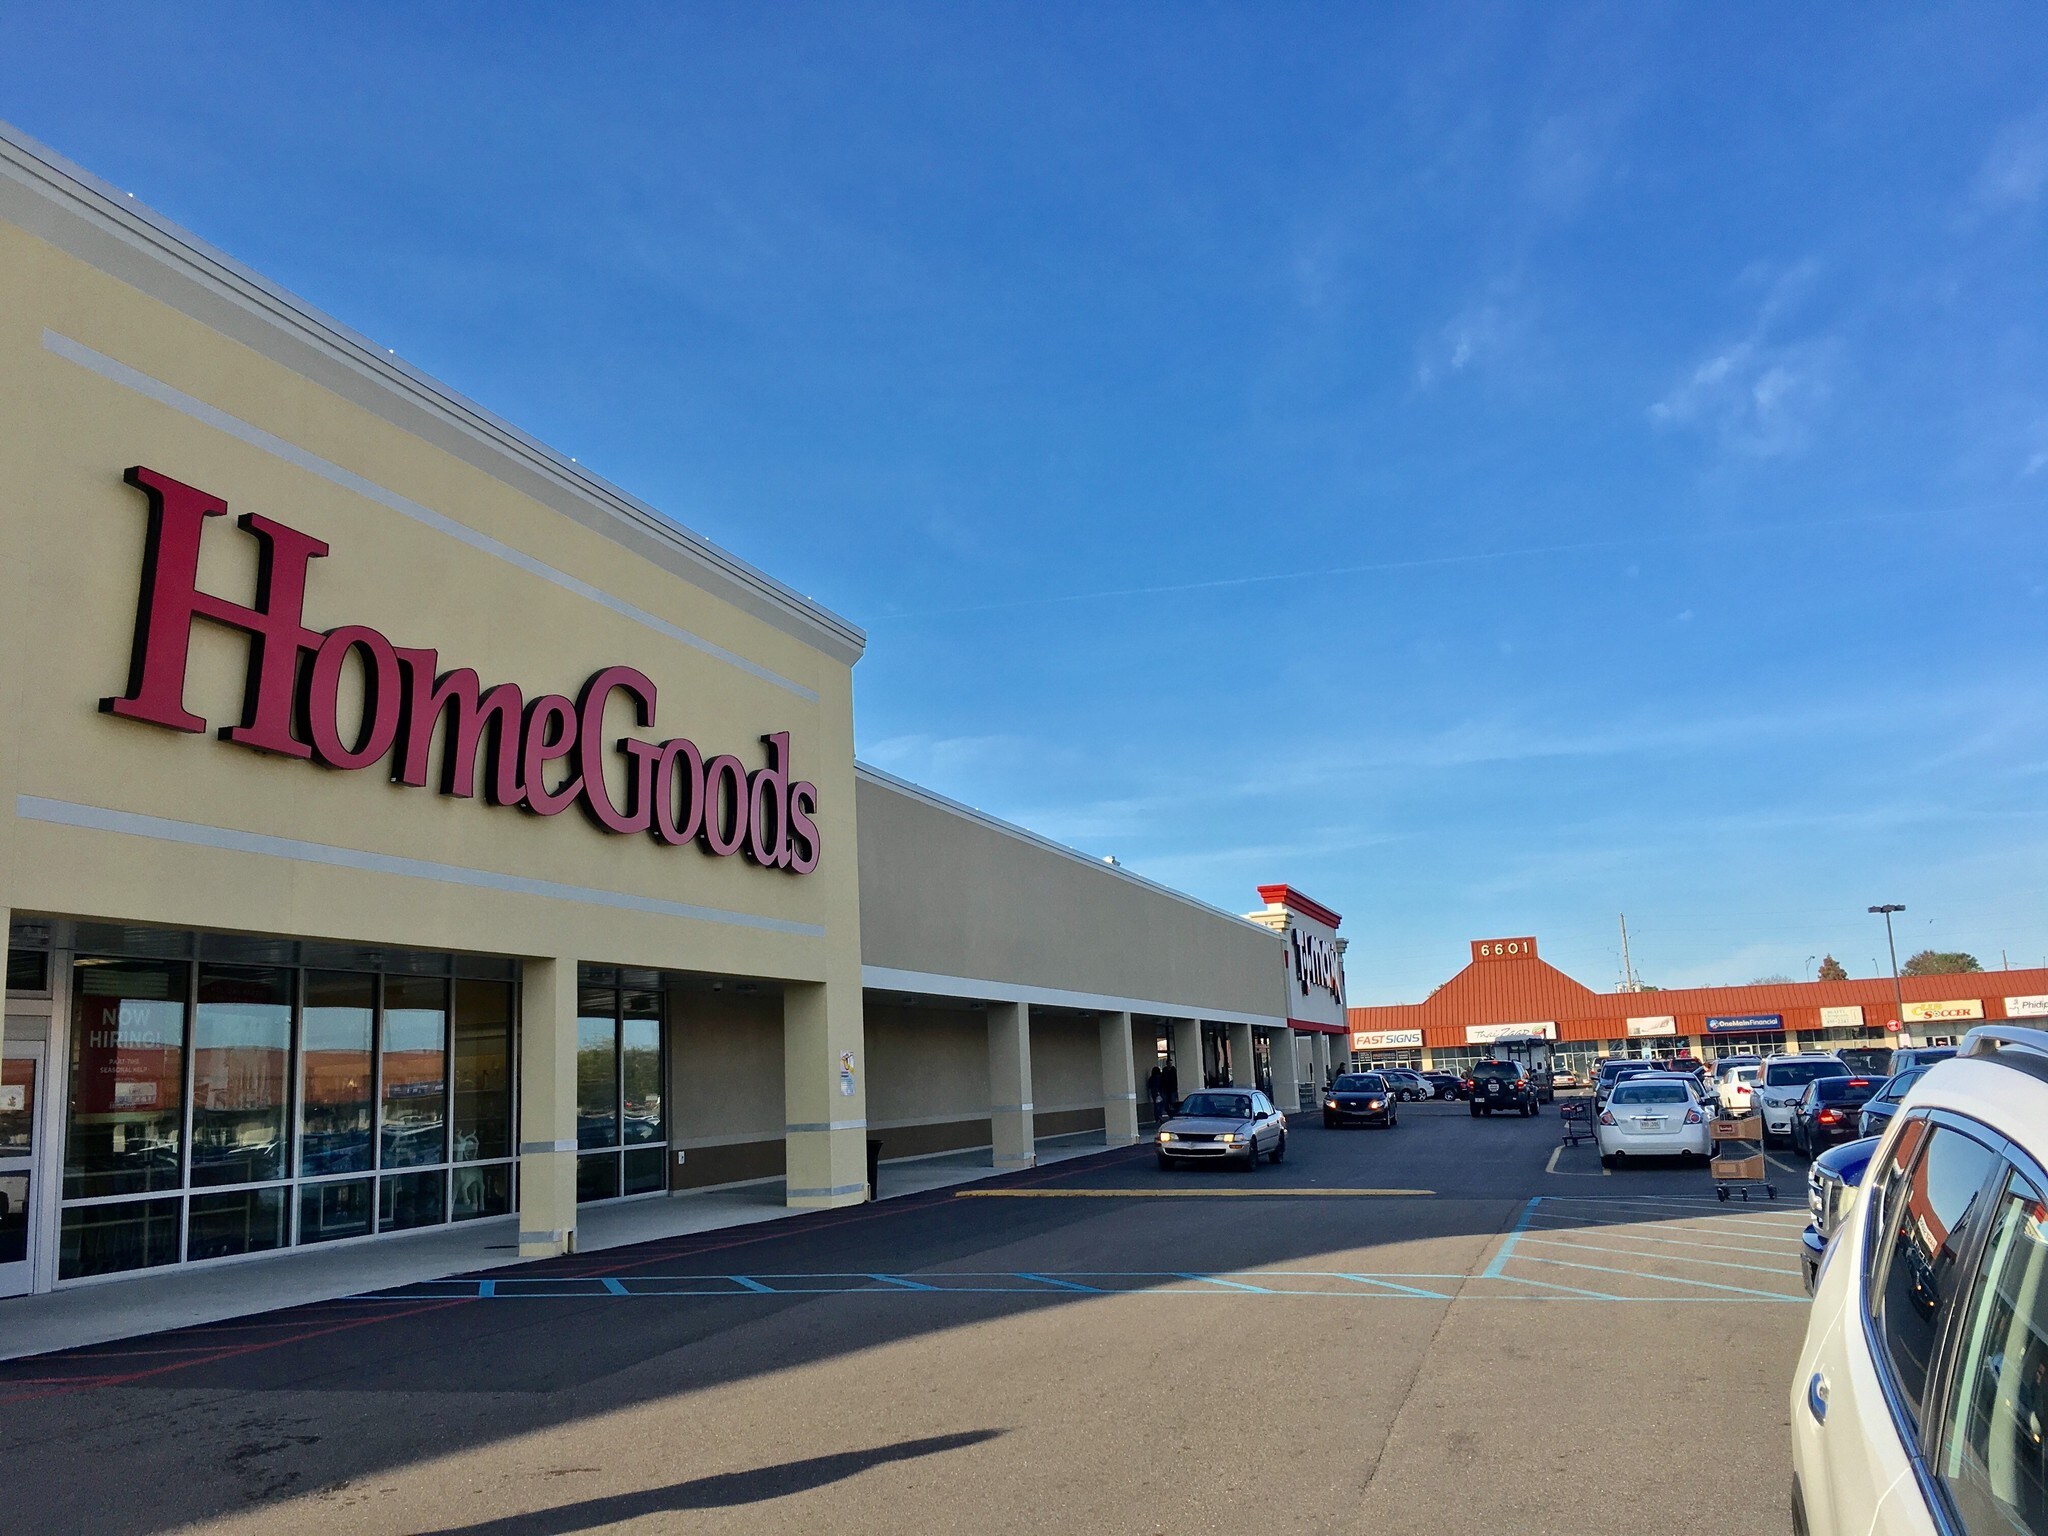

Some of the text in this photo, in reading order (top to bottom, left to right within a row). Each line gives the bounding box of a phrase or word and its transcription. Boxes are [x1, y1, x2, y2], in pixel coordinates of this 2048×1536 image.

[98, 465, 821, 876] HomeGoods
[1481, 941, 1529, 956] 6601
[102, 1008, 150, 1026] NOW
[89, 1030, 160, 1049] HIRING!
